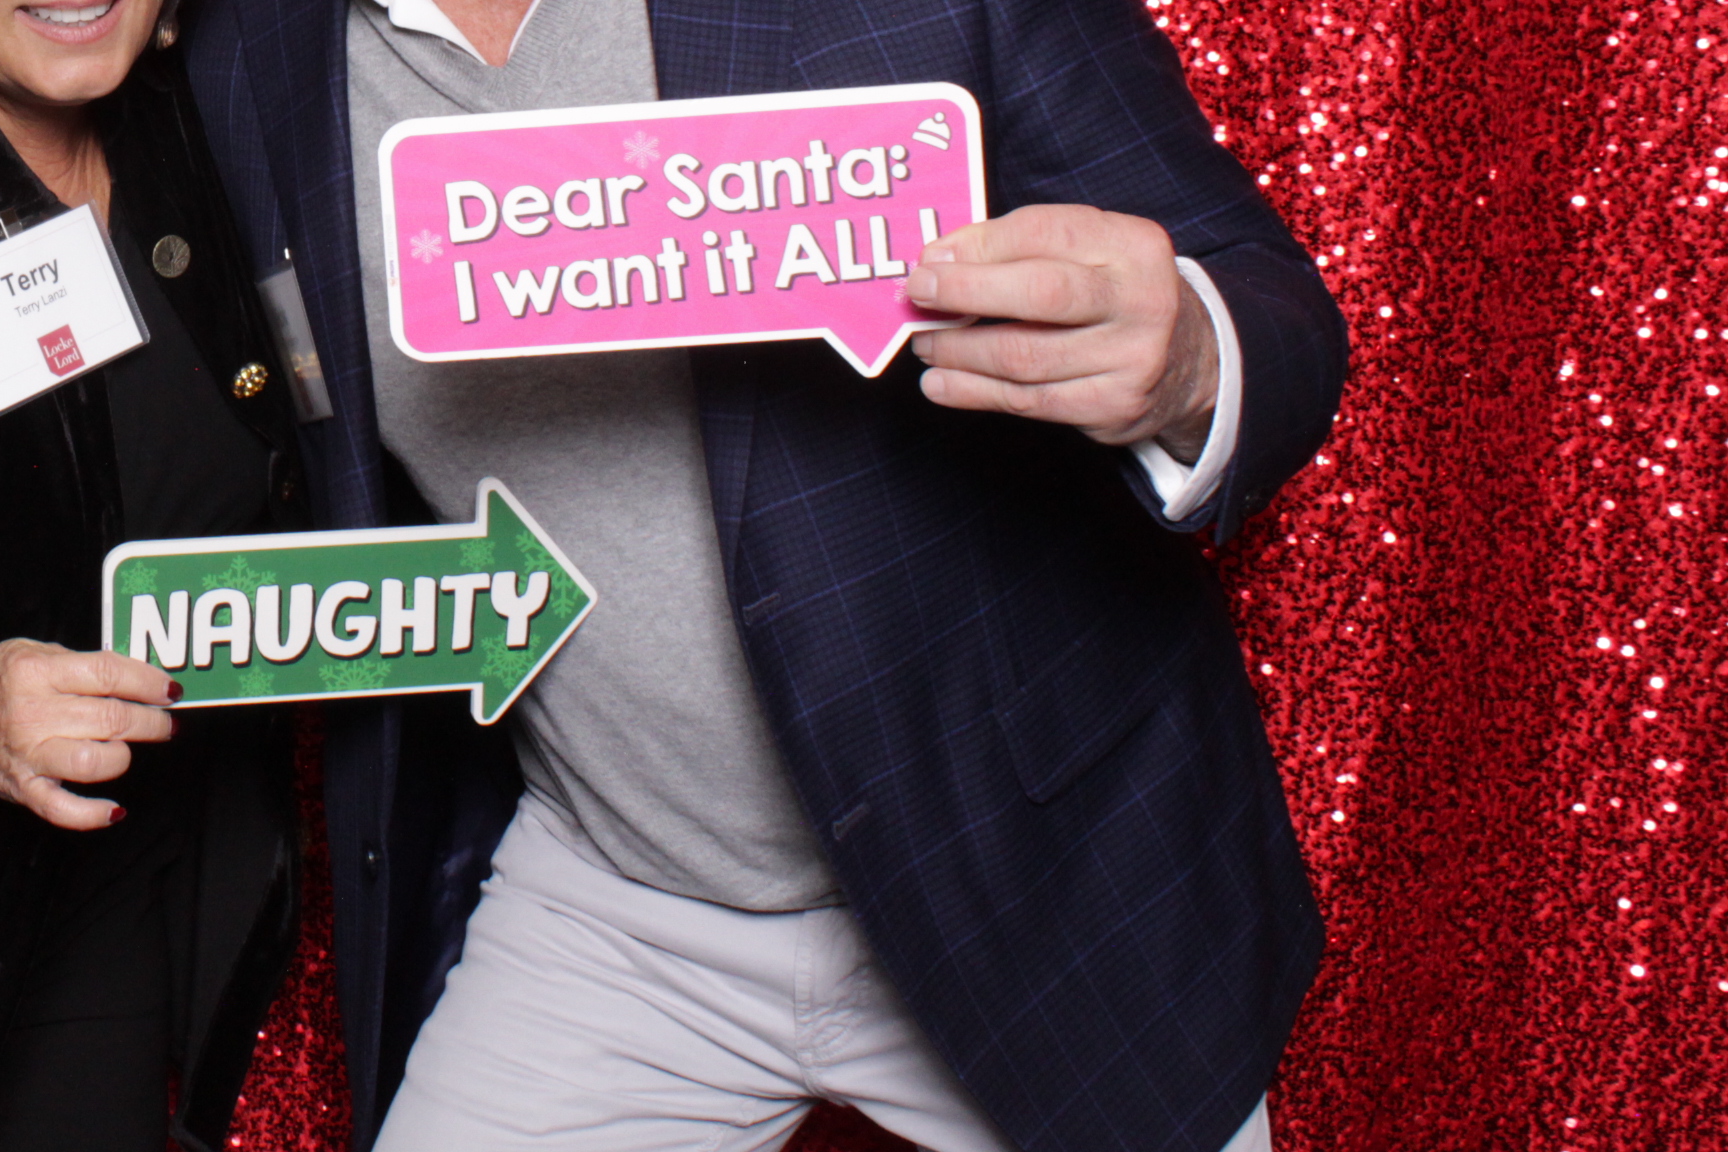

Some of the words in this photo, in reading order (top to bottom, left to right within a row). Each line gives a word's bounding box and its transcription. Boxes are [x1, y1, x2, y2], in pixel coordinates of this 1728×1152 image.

[445, 175, 648, 245] Dear
[663, 139, 910, 220] Santa:
[0, 258, 59, 296] Terry
[453, 260, 479, 324] I
[491, 237, 688, 318] want
[702, 230, 756, 297] it
[14, 300, 40, 318] Terry
[40, 285, 68, 306] Lanzi
[43, 337, 74, 358] Locke
[54, 348, 80, 369] Lord
[129, 570, 551, 671] NAUGHTY
